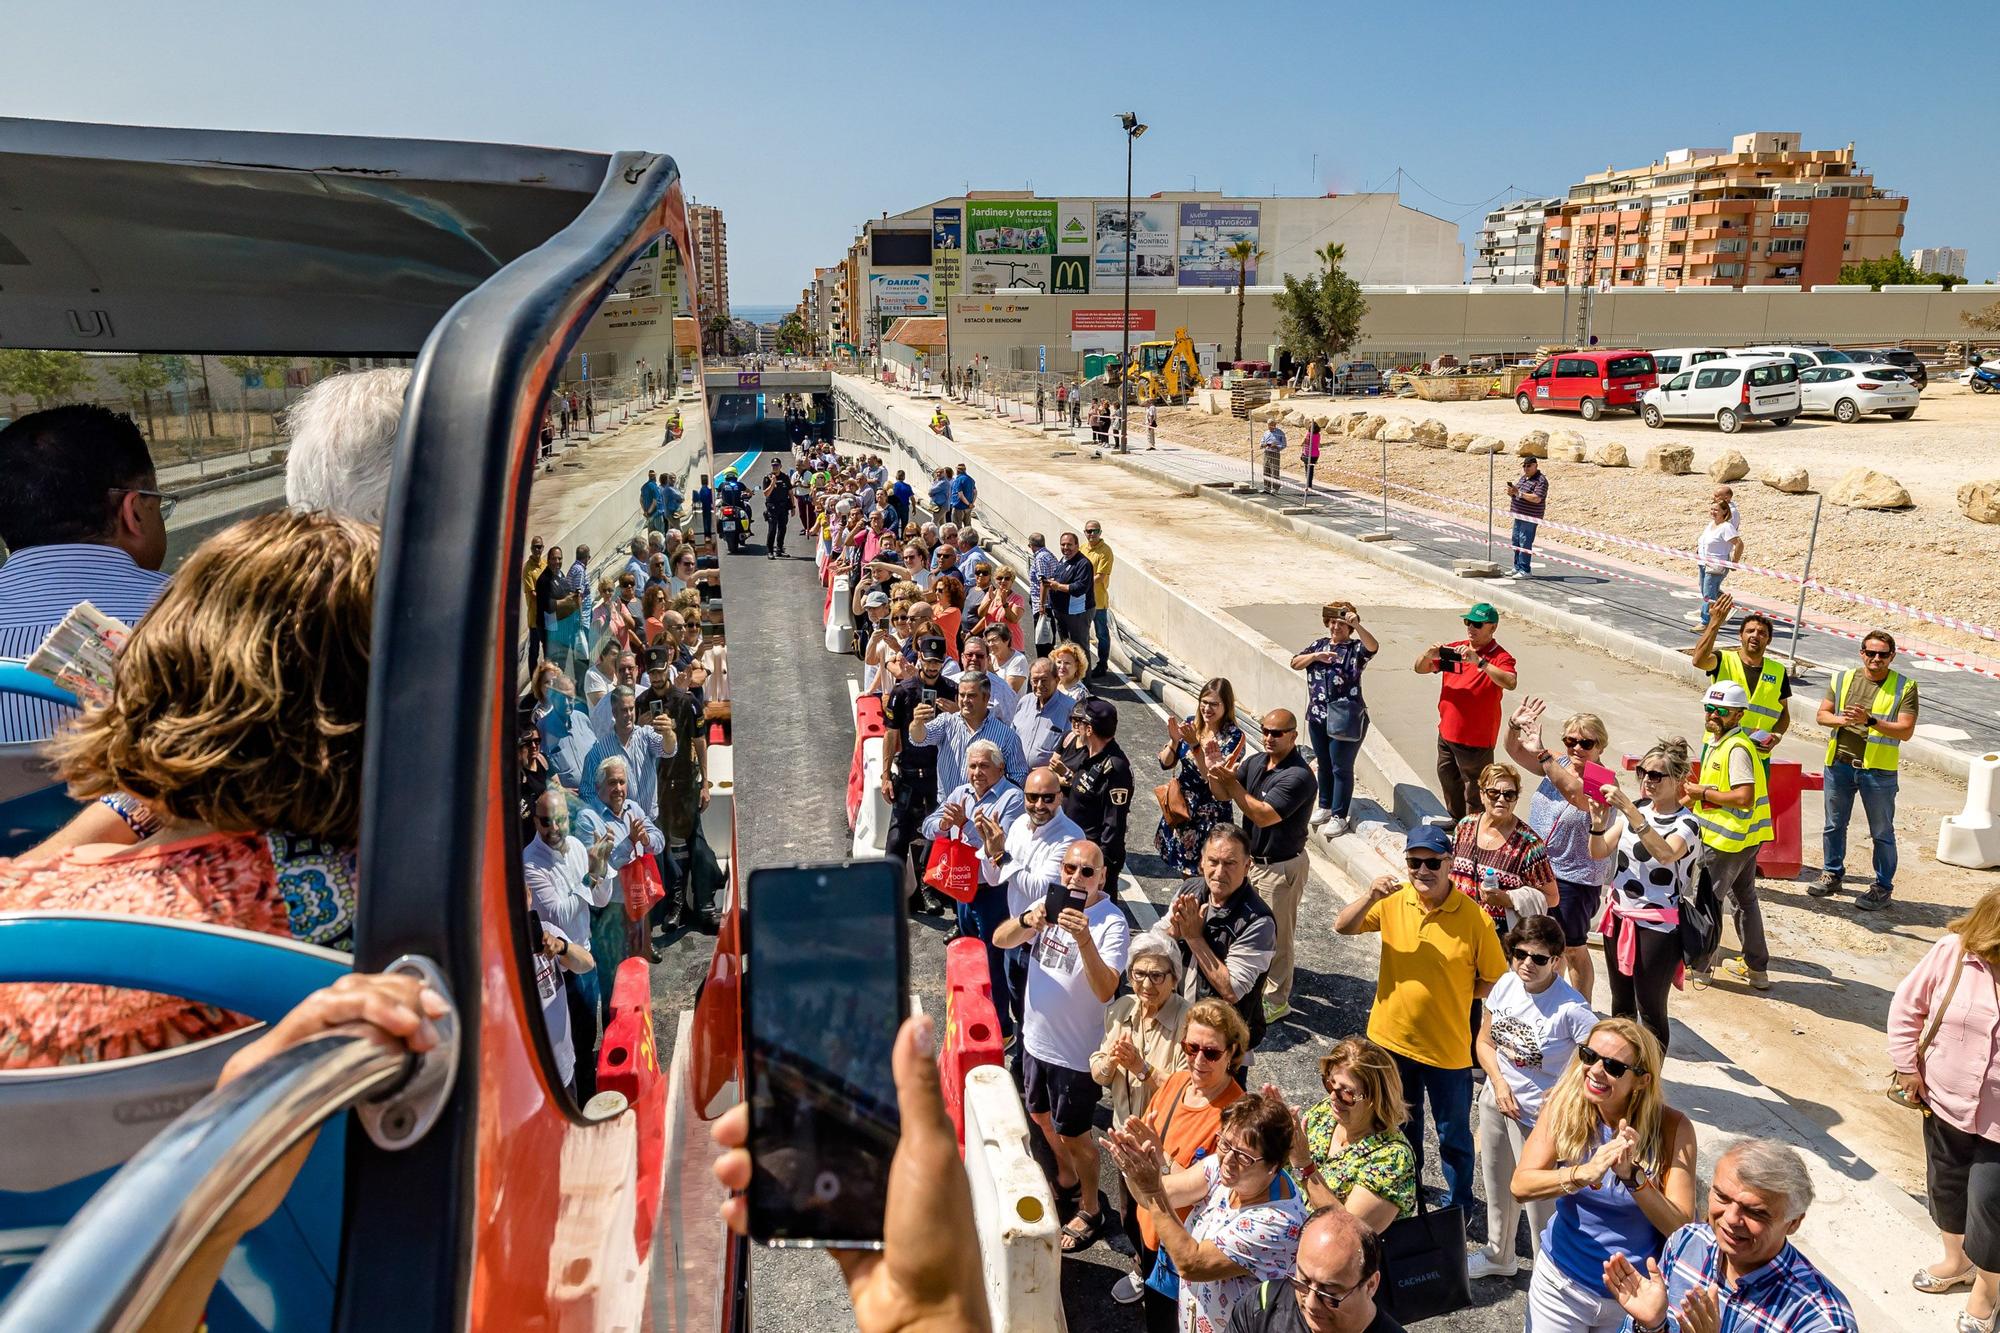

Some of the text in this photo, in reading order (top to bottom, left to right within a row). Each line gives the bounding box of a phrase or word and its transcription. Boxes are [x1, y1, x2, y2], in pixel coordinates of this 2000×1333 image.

[971, 208, 1052, 218] Jardines y terrazas
